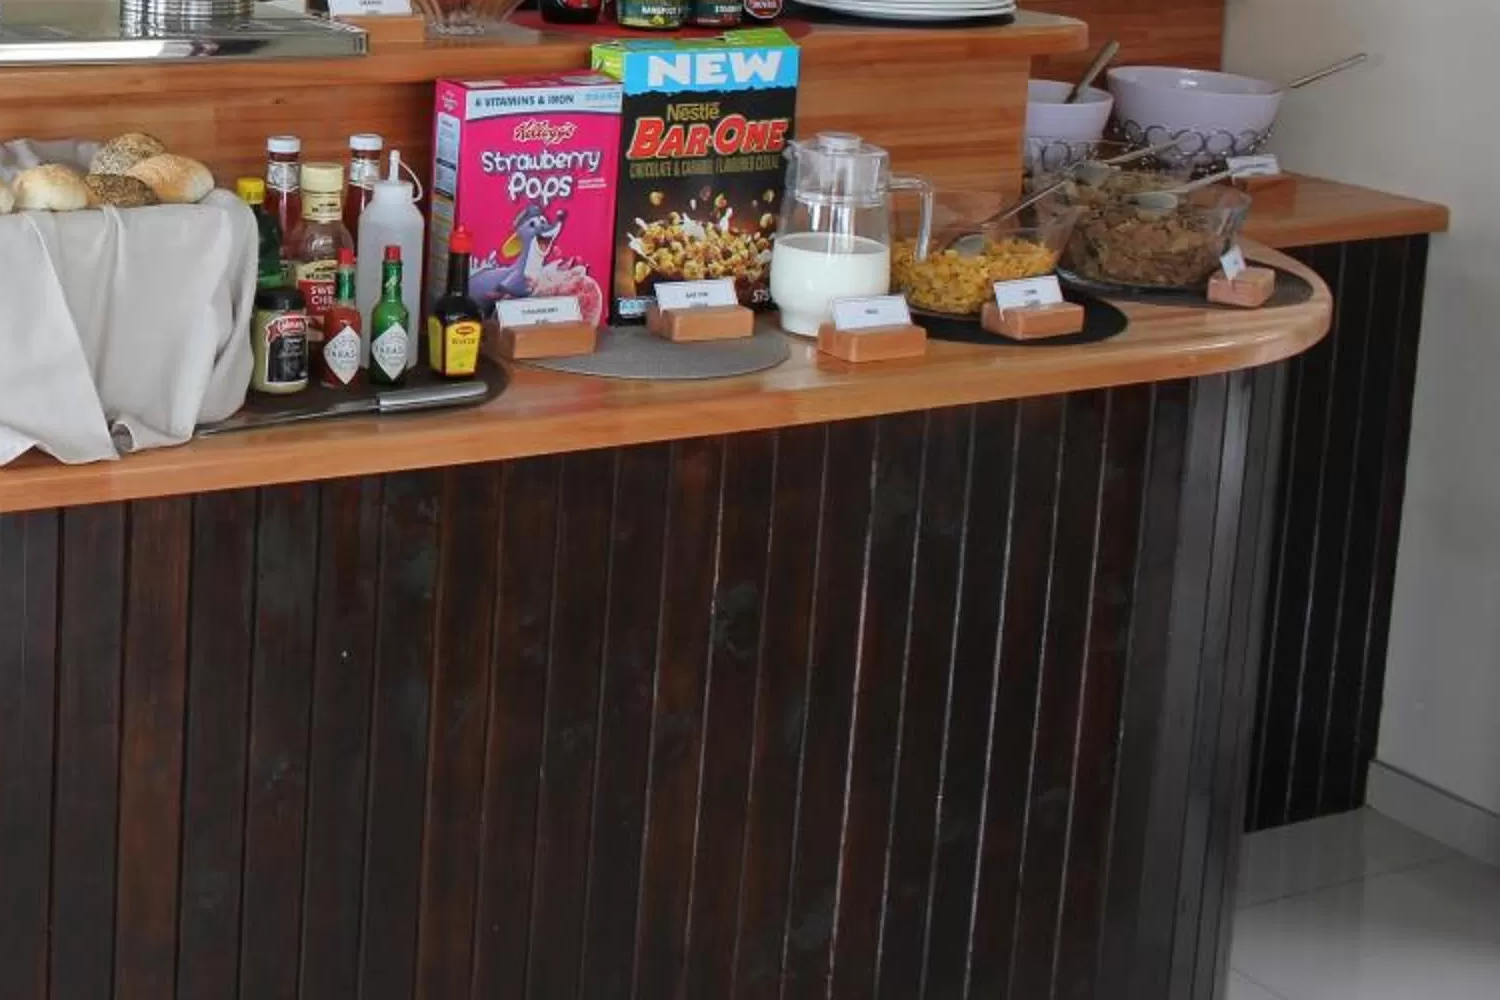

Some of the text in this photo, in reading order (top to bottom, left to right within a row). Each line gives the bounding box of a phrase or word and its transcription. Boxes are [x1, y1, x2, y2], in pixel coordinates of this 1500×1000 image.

[648, 51, 783, 87] NEW
[485, 96, 535, 108] VITAMINS
[481, 150, 601, 172] Strawberry
[509, 172, 573, 204] Pops
